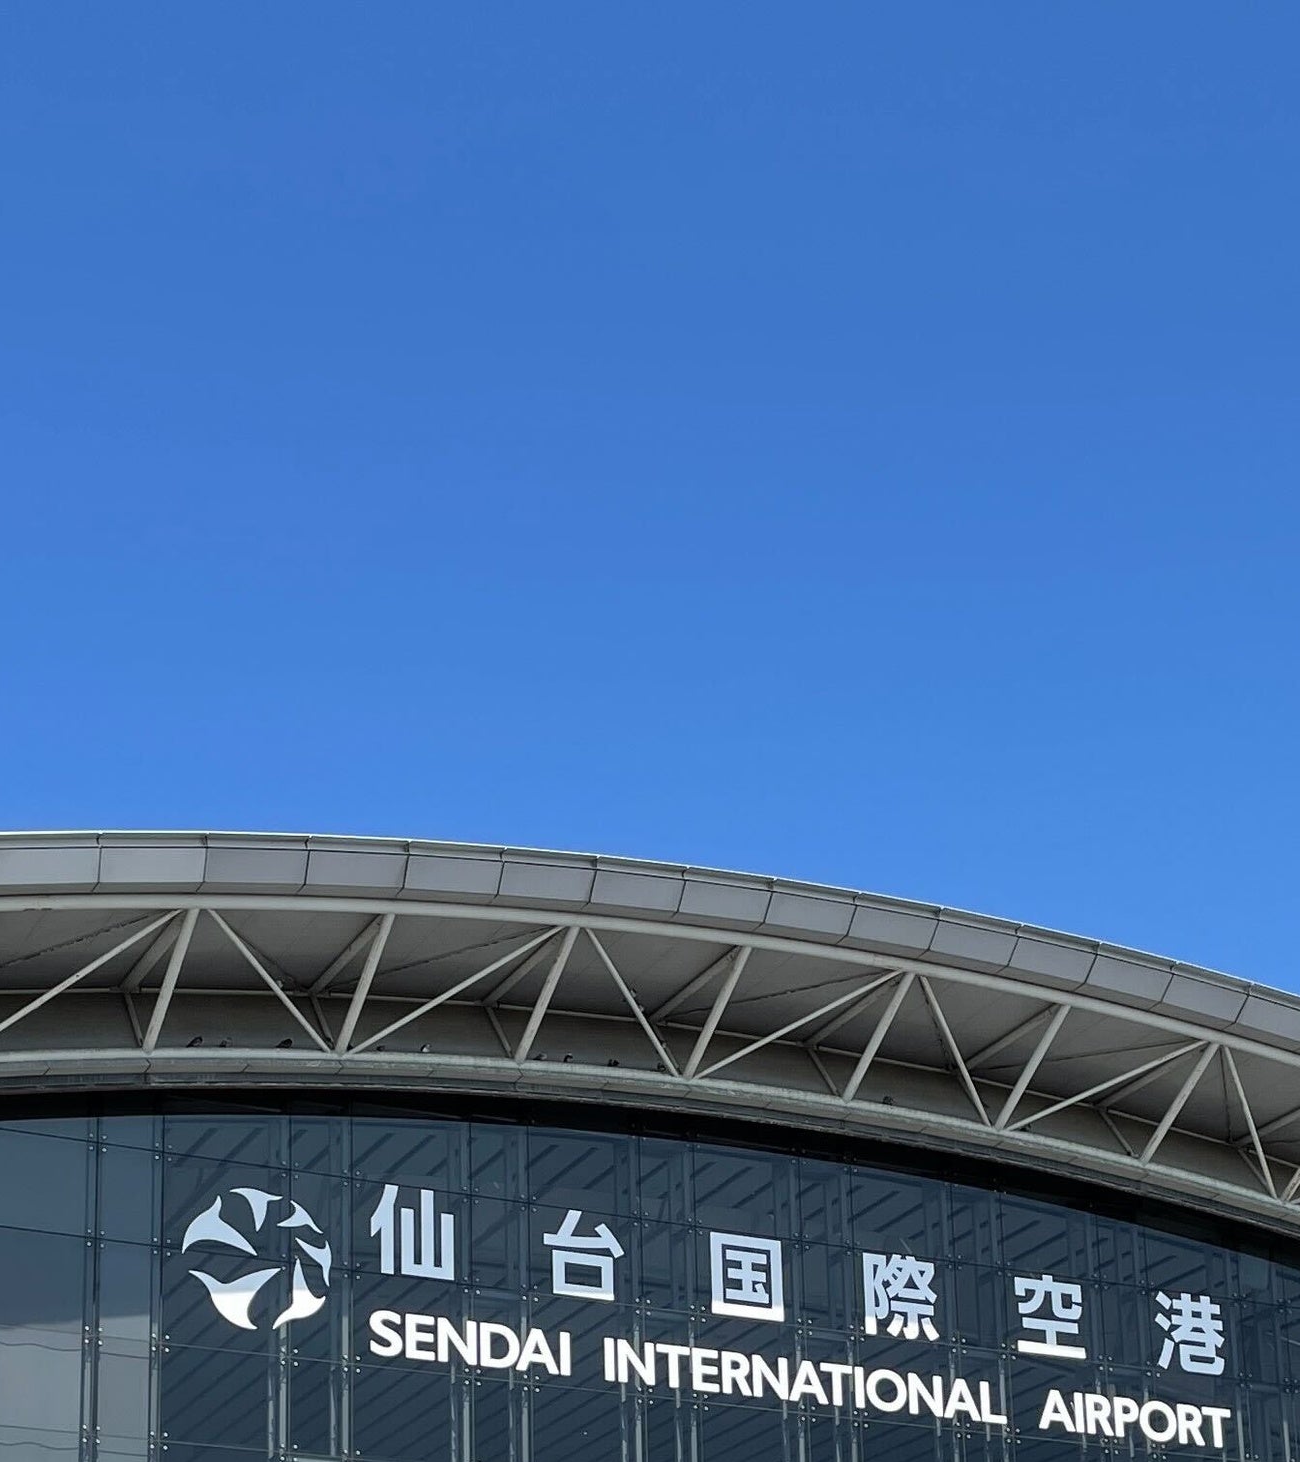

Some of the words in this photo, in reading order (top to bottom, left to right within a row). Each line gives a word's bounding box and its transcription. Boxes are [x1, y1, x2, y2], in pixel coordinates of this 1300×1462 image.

[370, 1183, 1226, 1376] 仙台国際空港
[368, 1309, 572, 1377] SENDAI
[602, 1336, 1008, 1426] INTERNATIONAL
[1038, 1388, 1232, 1449] AIRPORT
